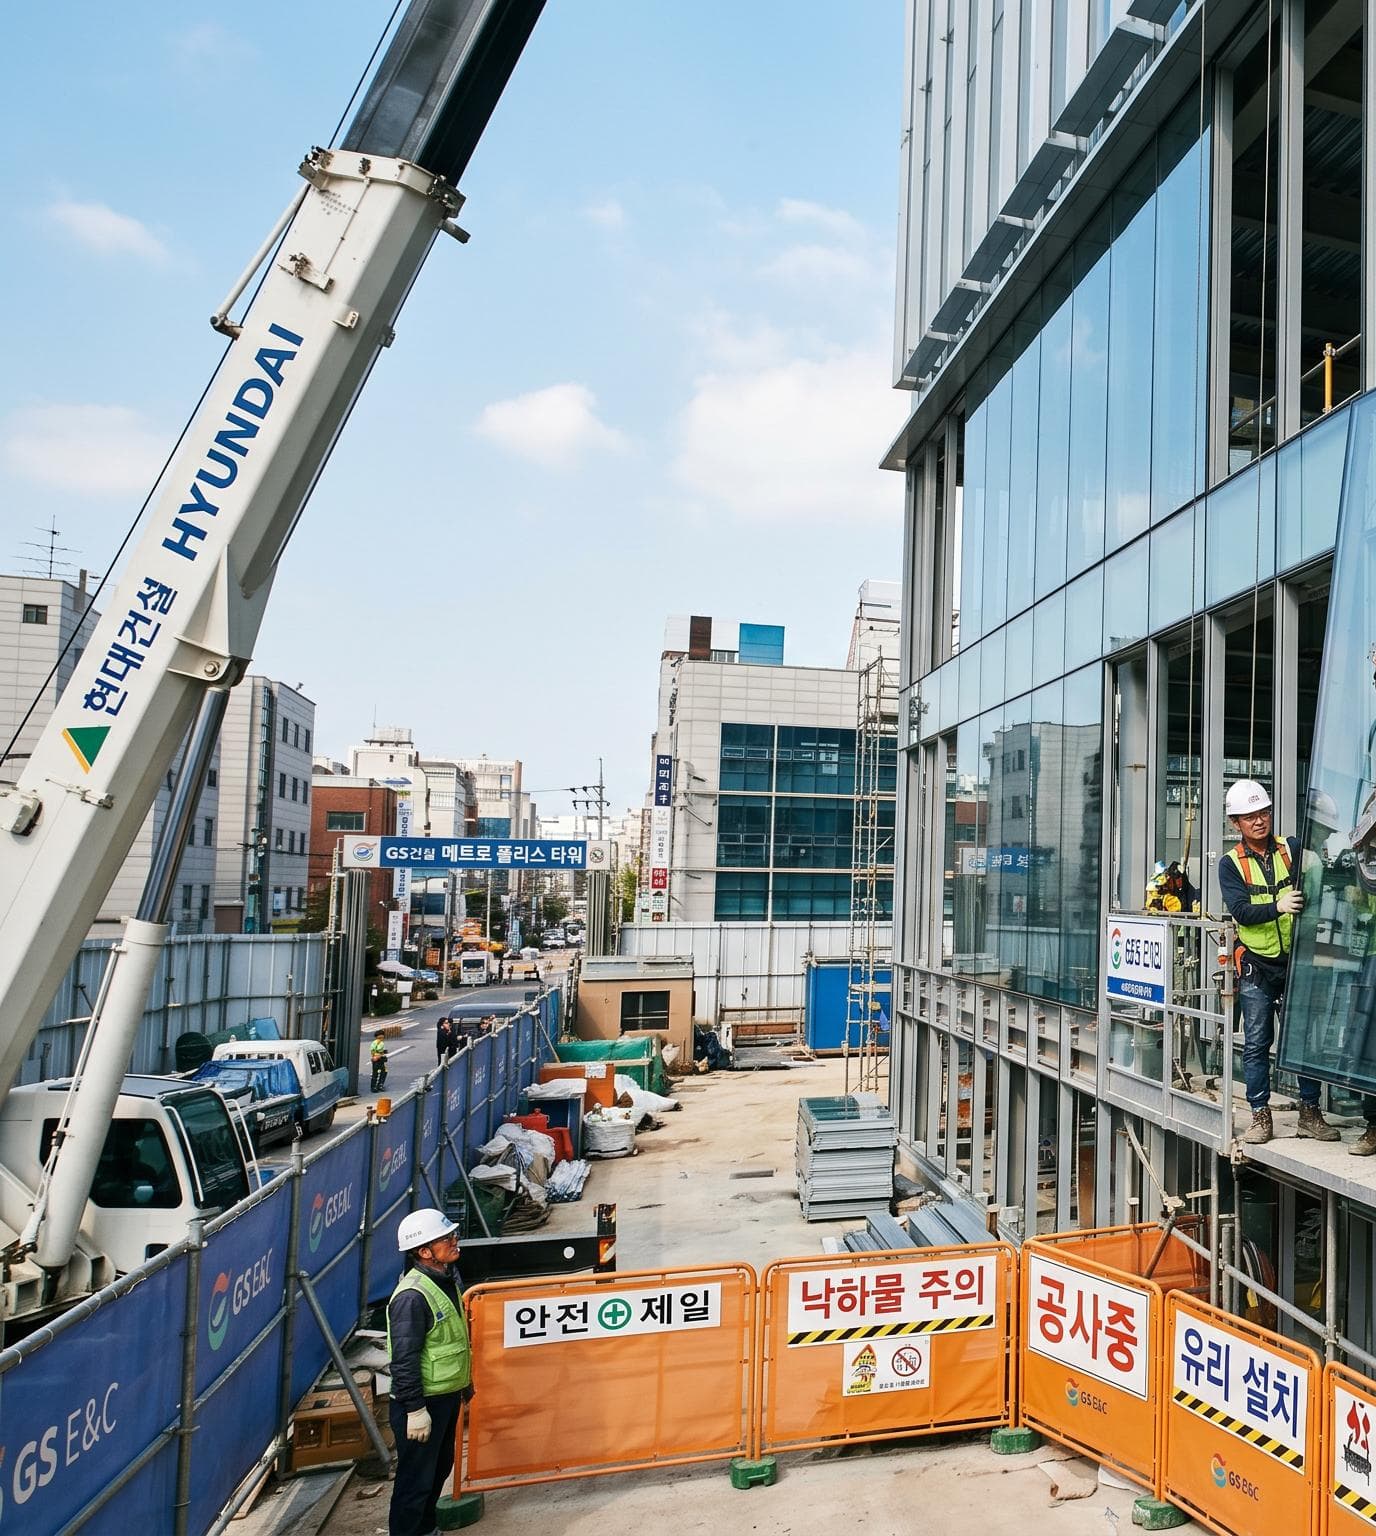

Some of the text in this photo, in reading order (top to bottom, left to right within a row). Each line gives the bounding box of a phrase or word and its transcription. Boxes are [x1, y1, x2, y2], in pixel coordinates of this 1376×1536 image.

[83, 323, 304, 717] 현대건설 HYUNDAI
[441, 844, 493, 863] 메트로
[496, 845, 547, 864] 폴리스
[551, 846, 583, 865] 타워
[232, 1267, 251, 1316] GS
[515, 1290, 710, 1339] 안전 제일
[802, 1265, 984, 1319] 낙하물 주의
[1037, 1275, 1138, 1373] 공사중
[1181, 1328, 1299, 1438] 유리 설치
[13, 1382, 119, 1505] GS E&C
